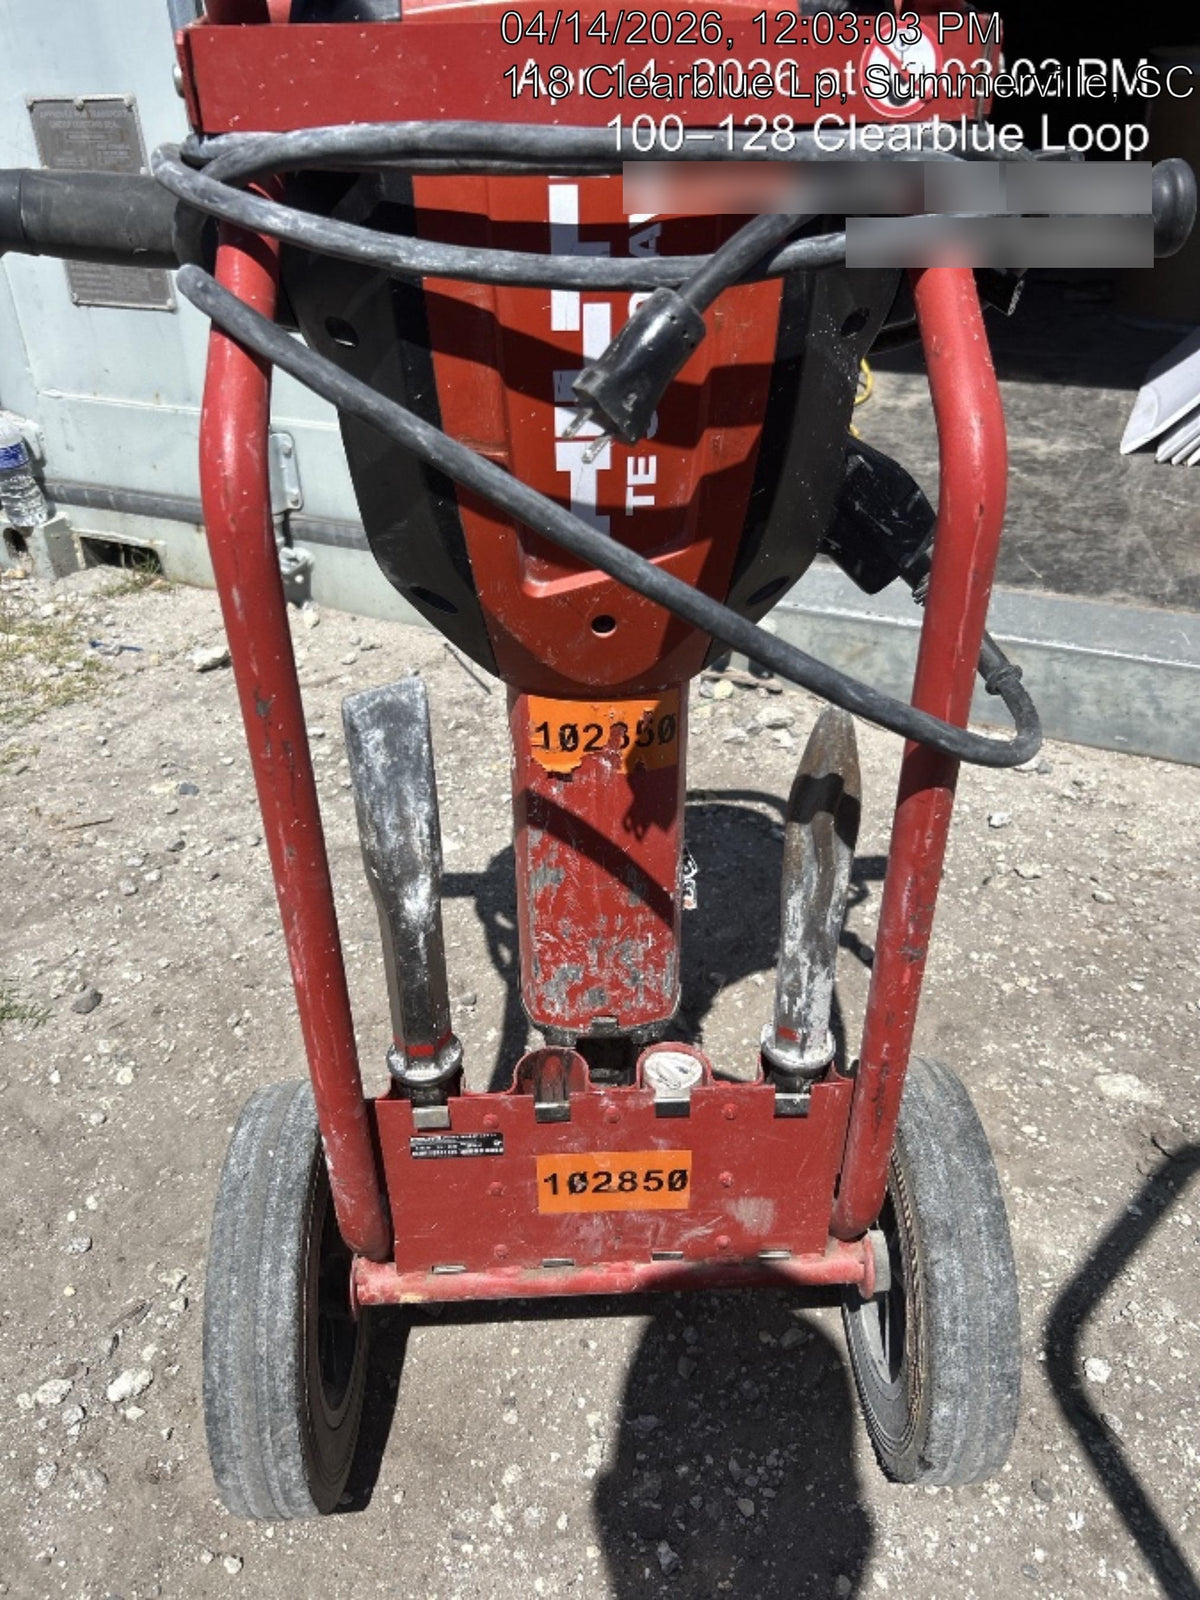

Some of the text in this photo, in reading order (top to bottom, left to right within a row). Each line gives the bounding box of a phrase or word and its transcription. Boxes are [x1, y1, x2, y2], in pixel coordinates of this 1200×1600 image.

[548, 175, 611, 537] HILT
[626, 455, 657, 516] TE
[543, 1169, 689, 1195] 102850
